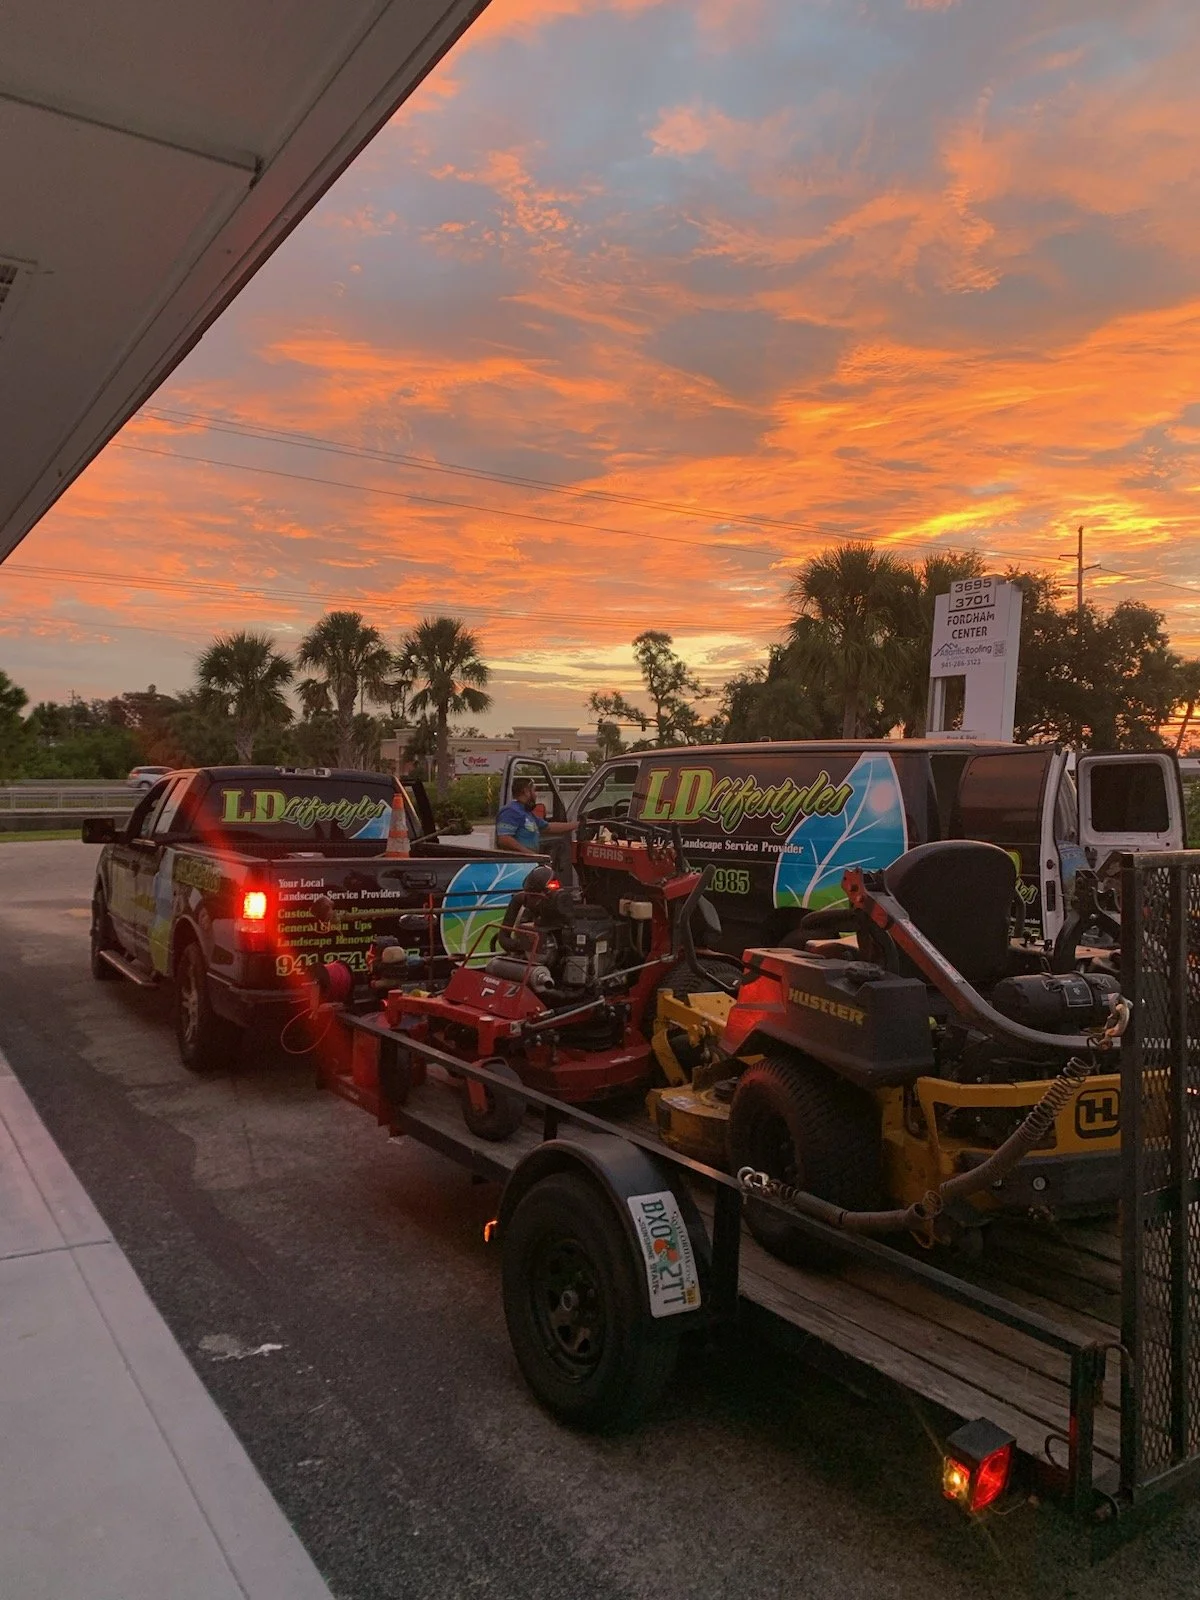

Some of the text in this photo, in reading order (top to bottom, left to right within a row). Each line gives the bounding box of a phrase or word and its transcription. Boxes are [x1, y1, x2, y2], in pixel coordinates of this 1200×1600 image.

[955, 578, 992, 593] 3695
[955, 594, 990, 608] 3701
[947, 611, 995, 626] FORDHAM
[951, 626, 987, 640] CENTER
[467, 756, 488, 765] Ryder
[639, 766, 854, 836] LD Lifestyles
[220, 788, 387, 830] LD Lifestyles
[681, 838, 722, 852] Landscape
[724, 839, 758, 852] Service
[761, 841, 804, 854] Provider
[586, 846, 624, 862] FERRIS
[278, 878, 325, 889] Your Local
[278, 888, 401, 904] Landscape Service Providers
[278, 922, 318, 934] General
[354, 921, 372, 932] Ups
[277, 936, 332, 948] Landscape
[787, 987, 866, 1029] HUSTLER
[640, 1221, 660, 1292] SUNSHINE STATE
